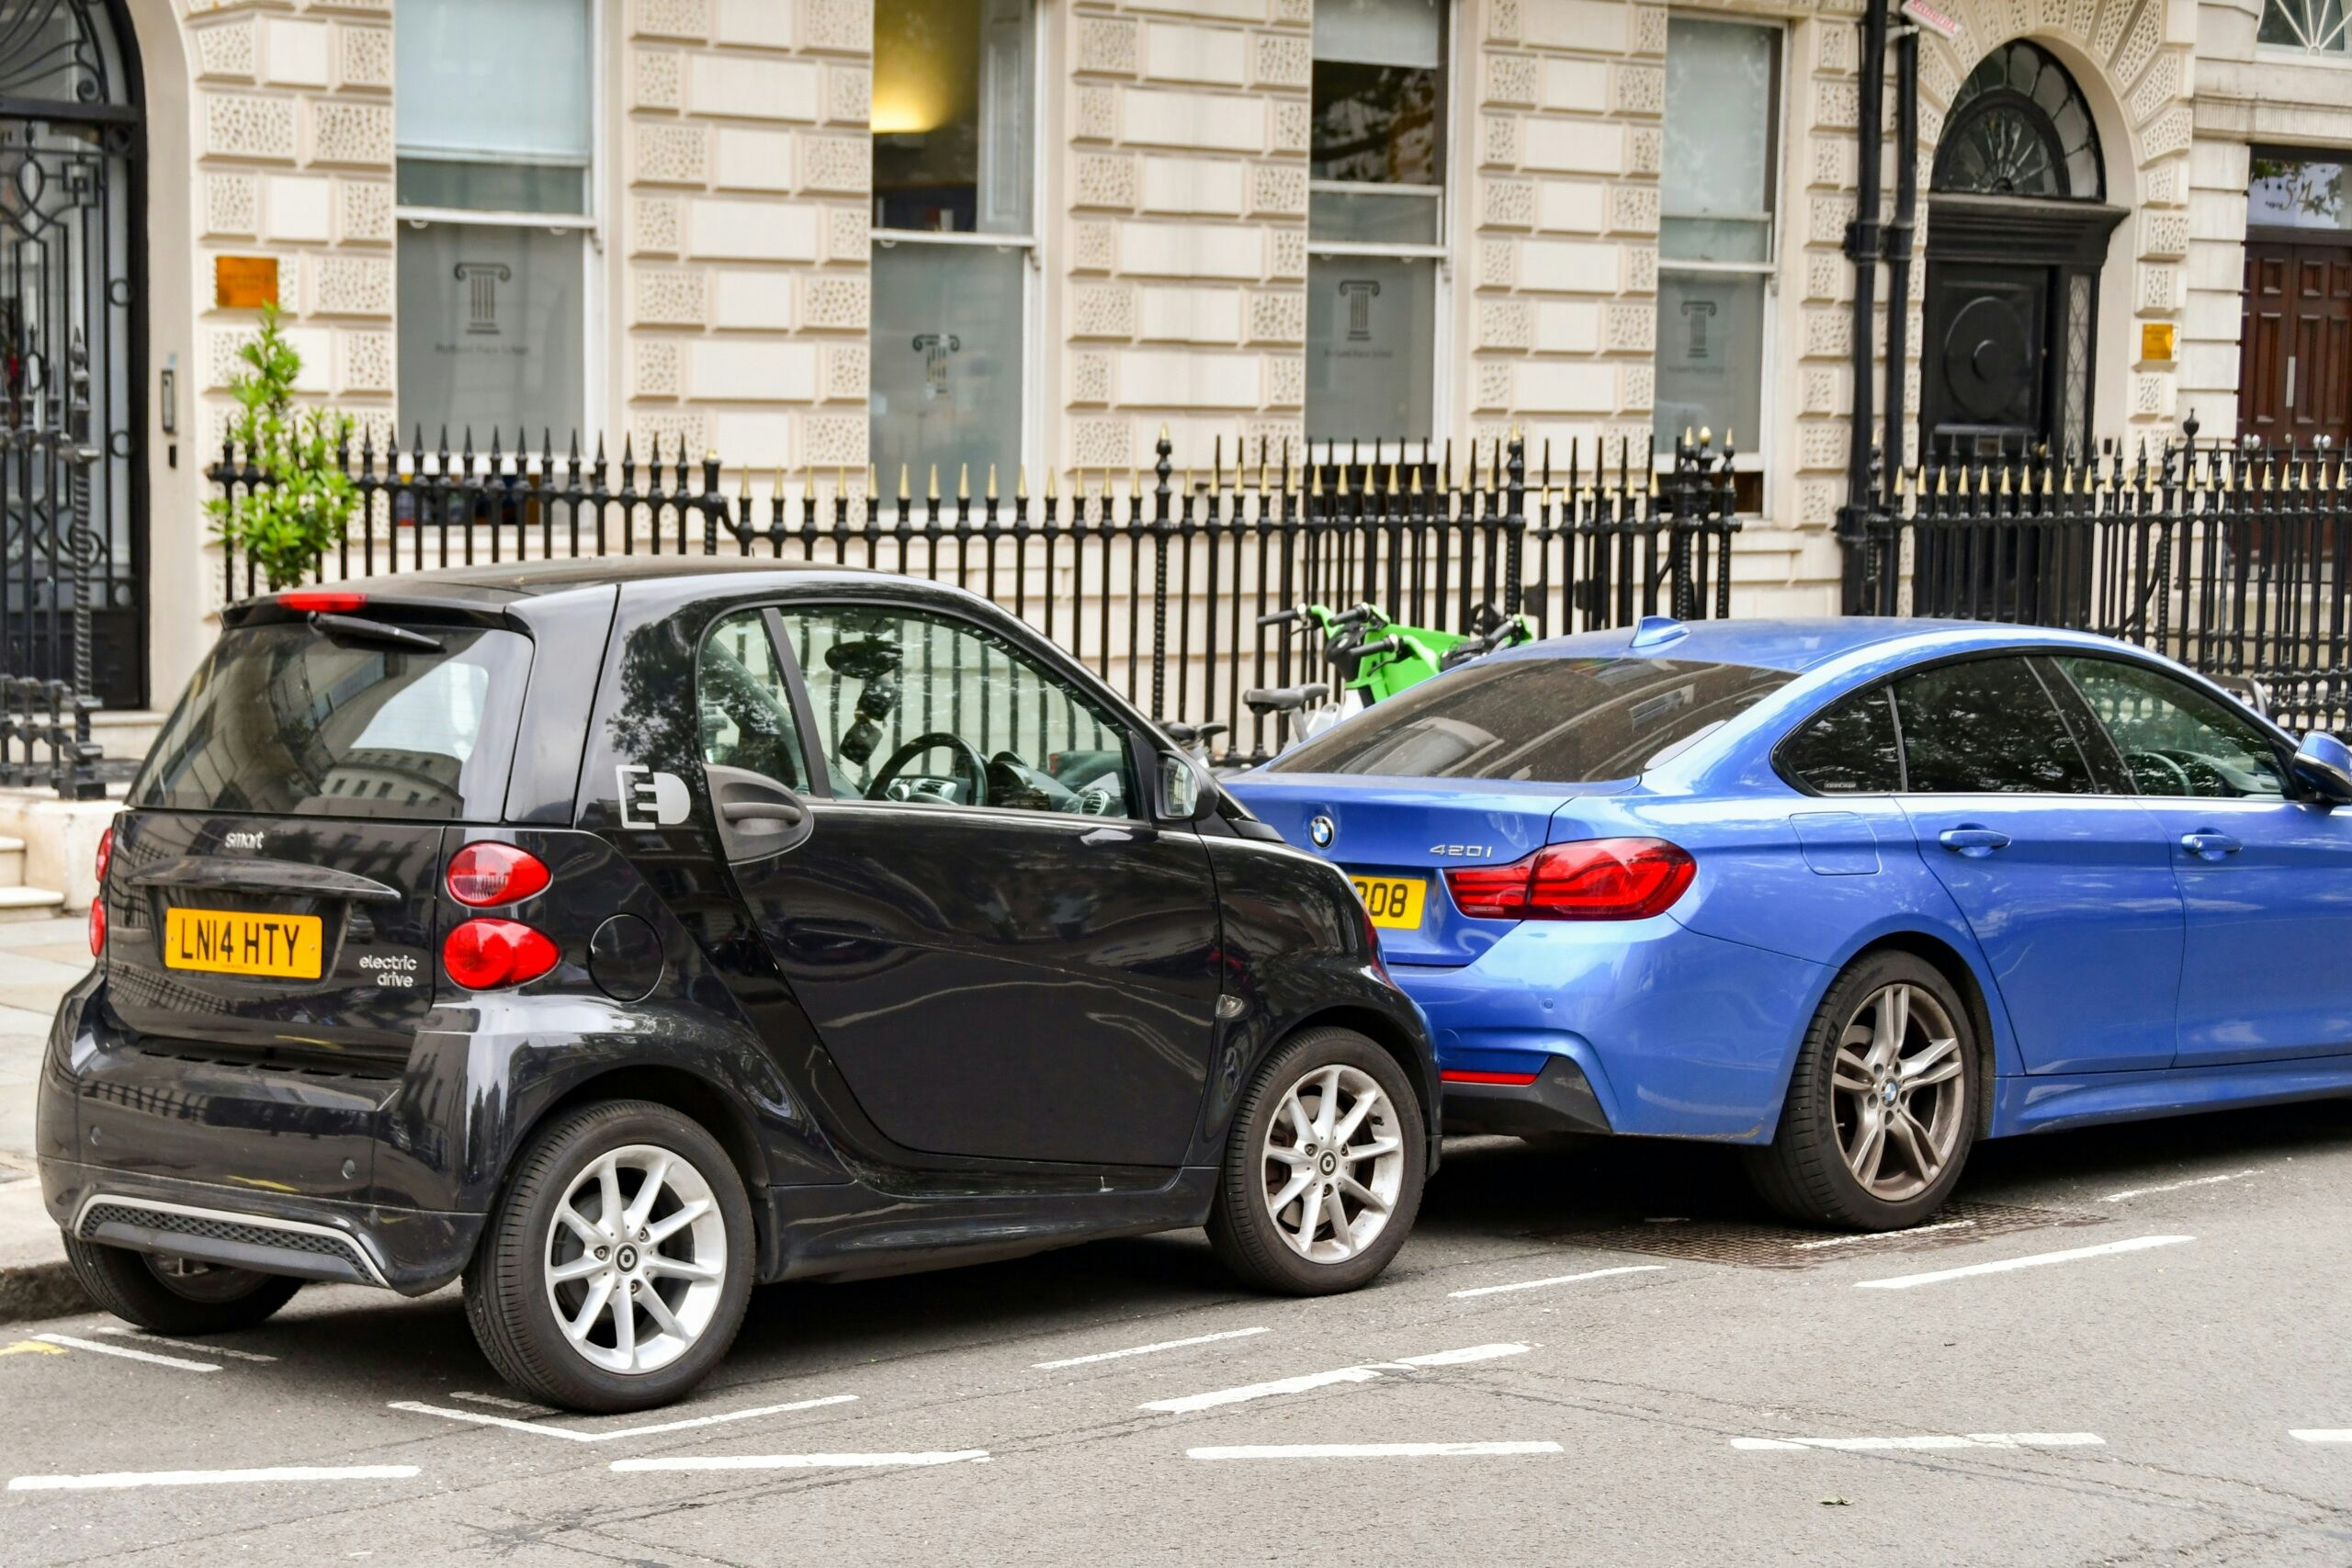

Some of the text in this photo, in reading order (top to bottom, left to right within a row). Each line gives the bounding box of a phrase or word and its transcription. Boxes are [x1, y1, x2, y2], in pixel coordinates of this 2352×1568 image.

[225, 830, 265, 850] smart
[181, 918, 300, 967] LN14 HTY
[359, 954, 417, 971] electric
[377, 971, 414, 987] drive
